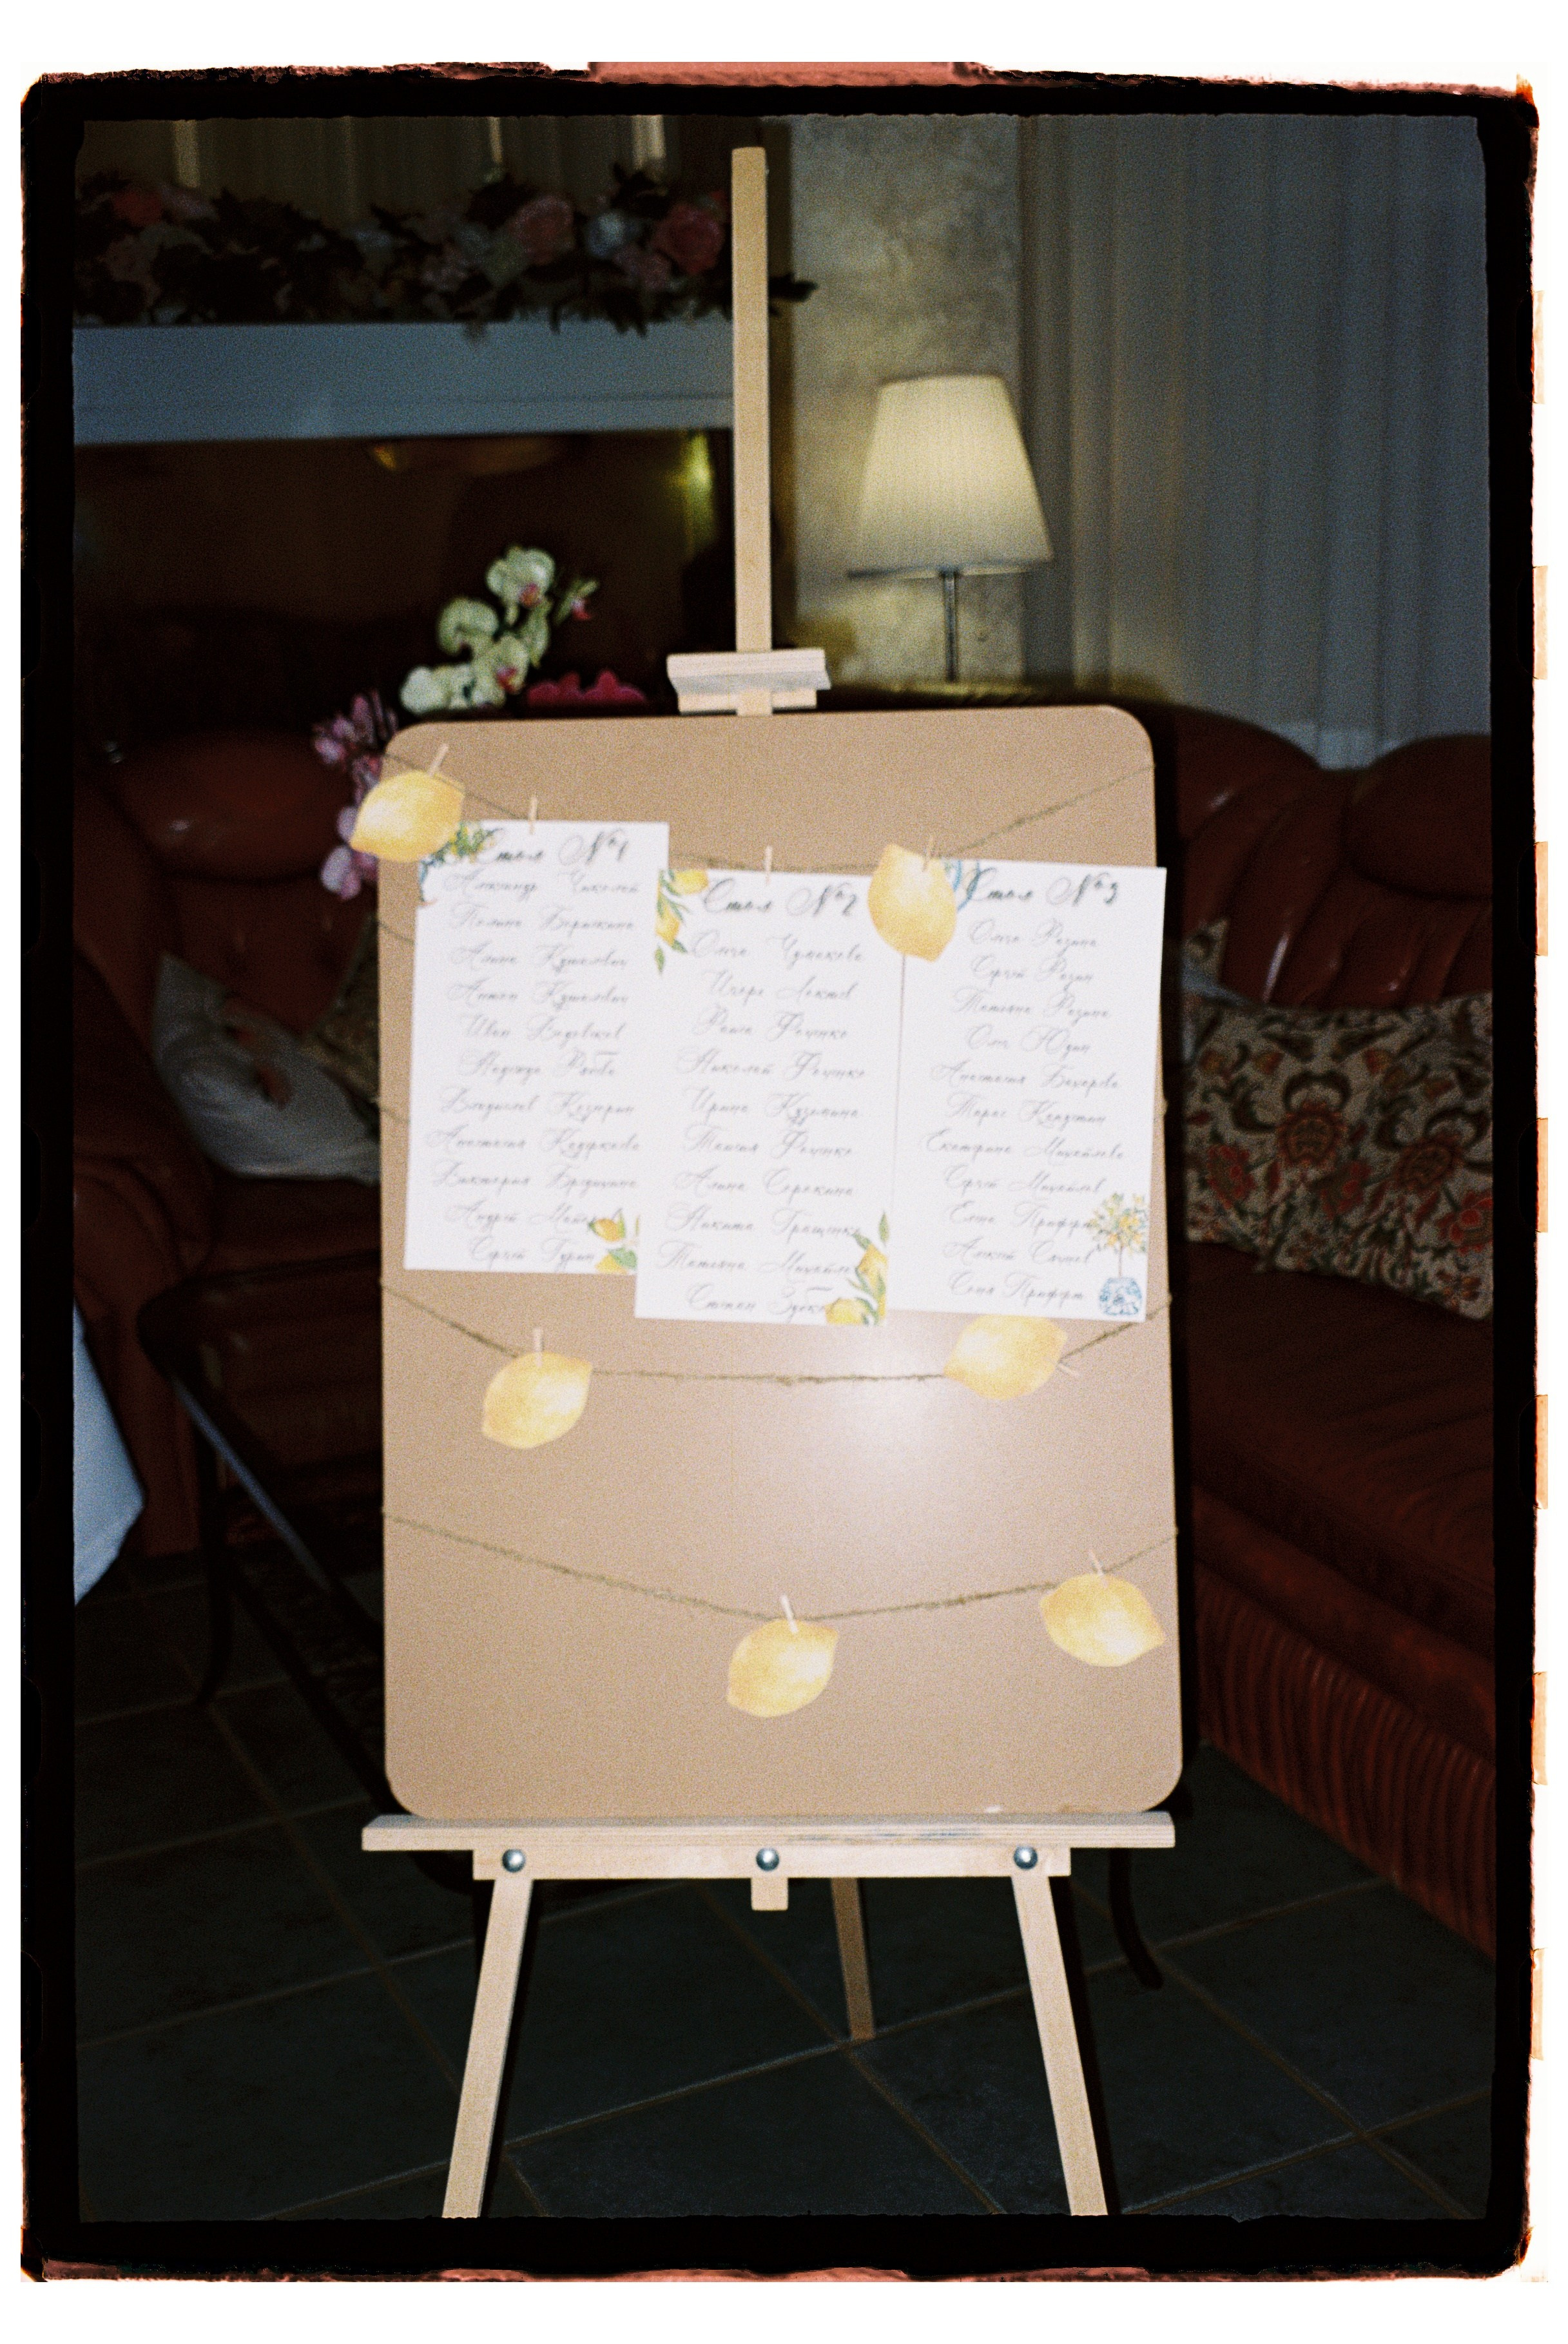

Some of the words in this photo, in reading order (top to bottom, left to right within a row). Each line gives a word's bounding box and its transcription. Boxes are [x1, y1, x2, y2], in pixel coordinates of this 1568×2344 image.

[474, 828, 544, 864] Стол
[559, 828, 628, 866] №1
[702, 877, 773, 914] Стол
[786, 882, 857, 917] №2
[963, 867, 1033, 902] Стол
[1045, 872, 1118, 907] №3
[450, 904, 523, 929] Полина
[969, 918, 1021, 945] Ольга
[451, 940, 518, 970] Алина
[691, 929, 748, 958] Ольга
[971, 954, 1025, 987] Сергей
[447, 976, 518, 1007] Антон
[702, 969, 764, 1007] Игорь
[953, 986, 1031, 1013] Татьяна
[460, 1012, 512, 1038] Иван
[460, 1050, 541, 1085] Надежда
[677, 1047, 773, 1075] Николай
[931, 1060, 1027, 1090] Анастасия
[440, 1086, 541, 1122] Владислав
[685, 1085, 749, 1125] Ирина
[946, 1090, 1007, 1127] Тарас
[427, 1124, 527, 1154] Анастасия
[684, 1123, 759, 1153] Таисия
[924, 1128, 1012, 1162] Екатерина
[433, 1160, 531, 1196] Виктория
[673, 1165, 744, 1197] Алина
[763, 1168, 853, 1205] Сорокина
[944, 1165, 998, 1197] Сергей
[445, 1199, 518, 1230] Андрей
[667, 1201, 755, 1232] Никита
[470, 1235, 526, 1268] Сергей
[659, 1240, 747, 1270] Татьяна
[944, 1236, 1016, 1266] Алексей
